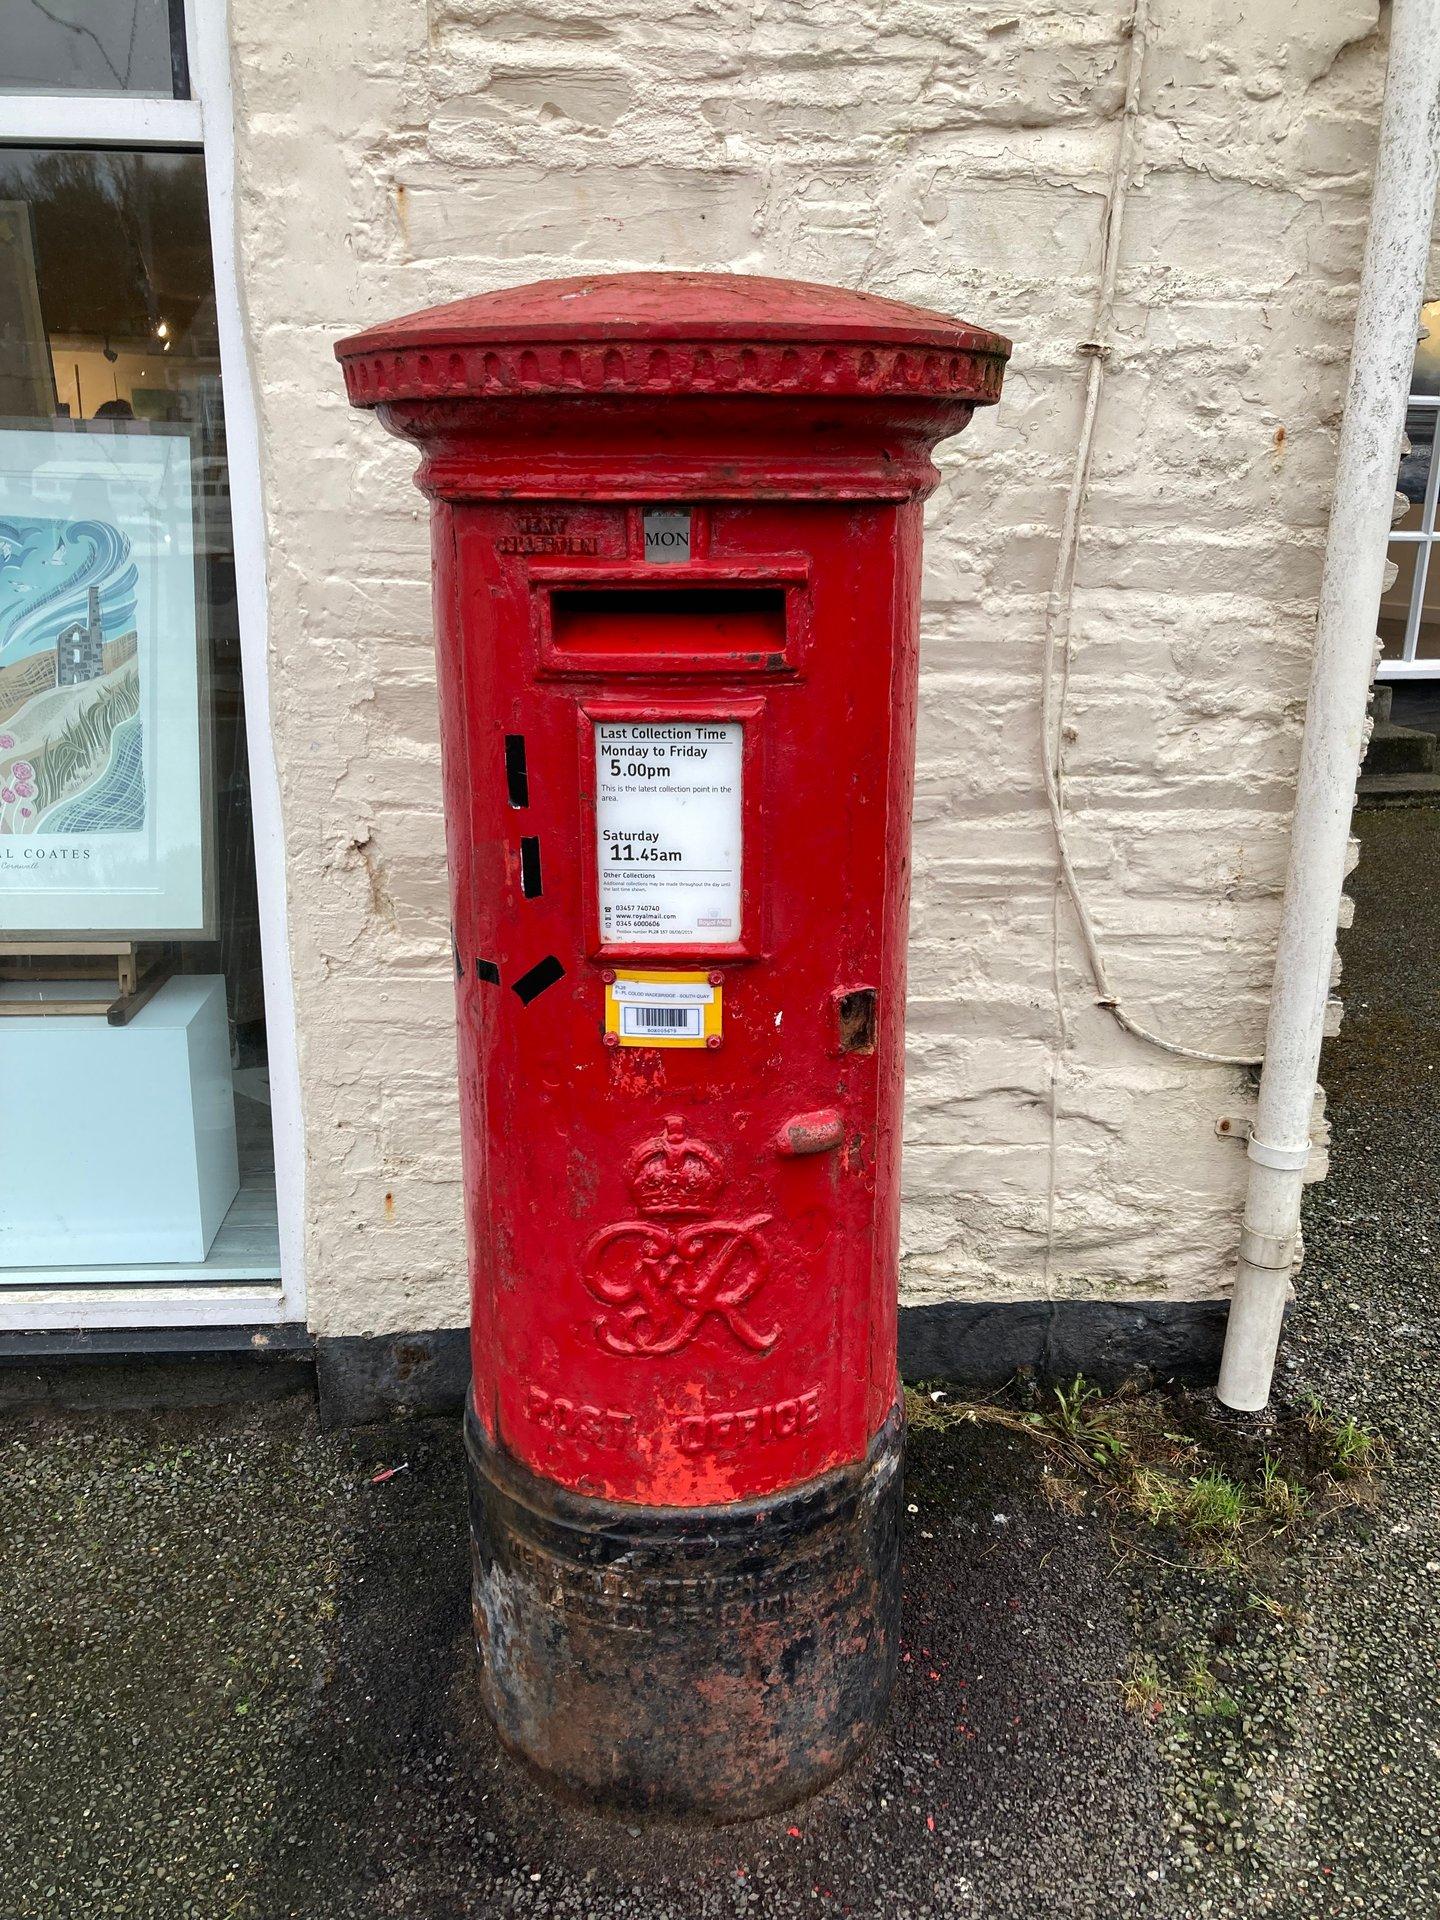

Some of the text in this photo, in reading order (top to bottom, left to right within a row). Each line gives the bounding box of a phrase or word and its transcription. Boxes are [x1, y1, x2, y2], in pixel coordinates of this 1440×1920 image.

[644, 532, 690, 547] MON
[601, 727, 727, 740] Last Collection Time
[601, 745, 708, 760] Monday to Friday
[610, 759, 671, 780] 5.00pm
[601, 784, 732, 795] This is the latest collection point in the
[603, 829, 660, 844] Saturday
[23, 848, 91, 859] COATES
[610, 844, 682, 862] 11.45am
[524, 1381, 826, 1451] POST OFFICE
